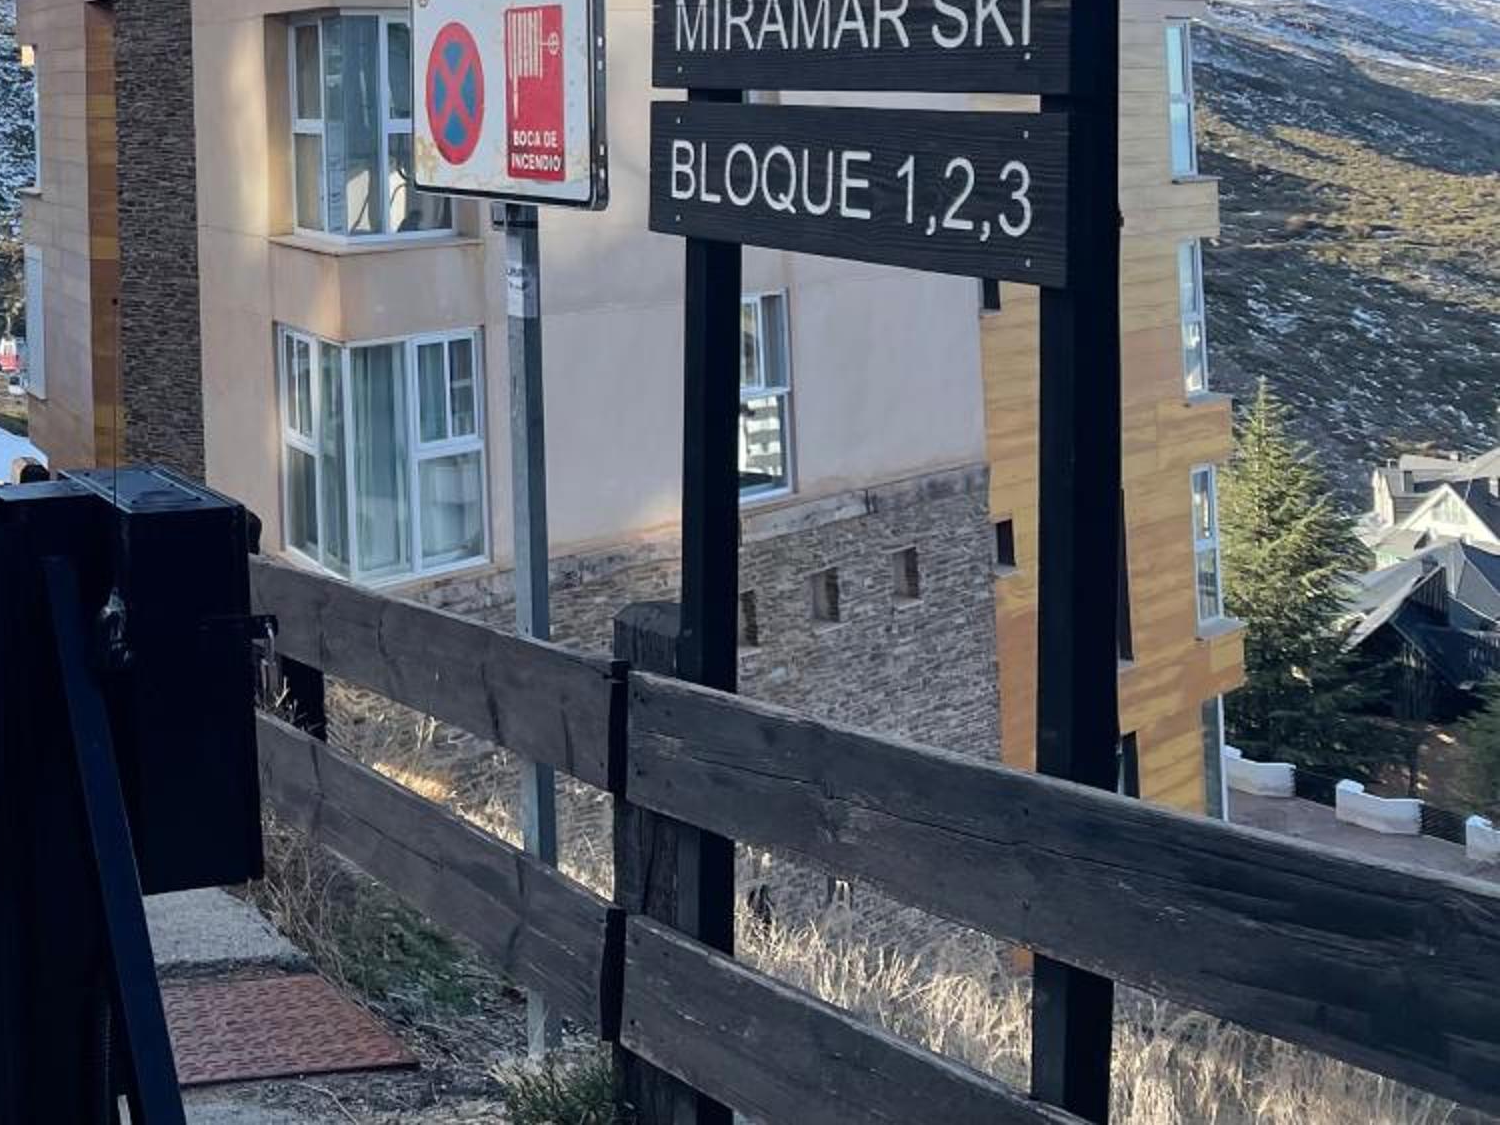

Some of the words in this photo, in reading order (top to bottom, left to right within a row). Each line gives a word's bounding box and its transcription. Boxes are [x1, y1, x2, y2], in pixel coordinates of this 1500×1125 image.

[513, 130, 540, 146] BOCA
[543, 130, 557, 148] DE
[511, 153, 561, 171] INCENDIO
[670, 140, 872, 219] BLOQUE
[897, 155, 1032, 241] 1,2,3
